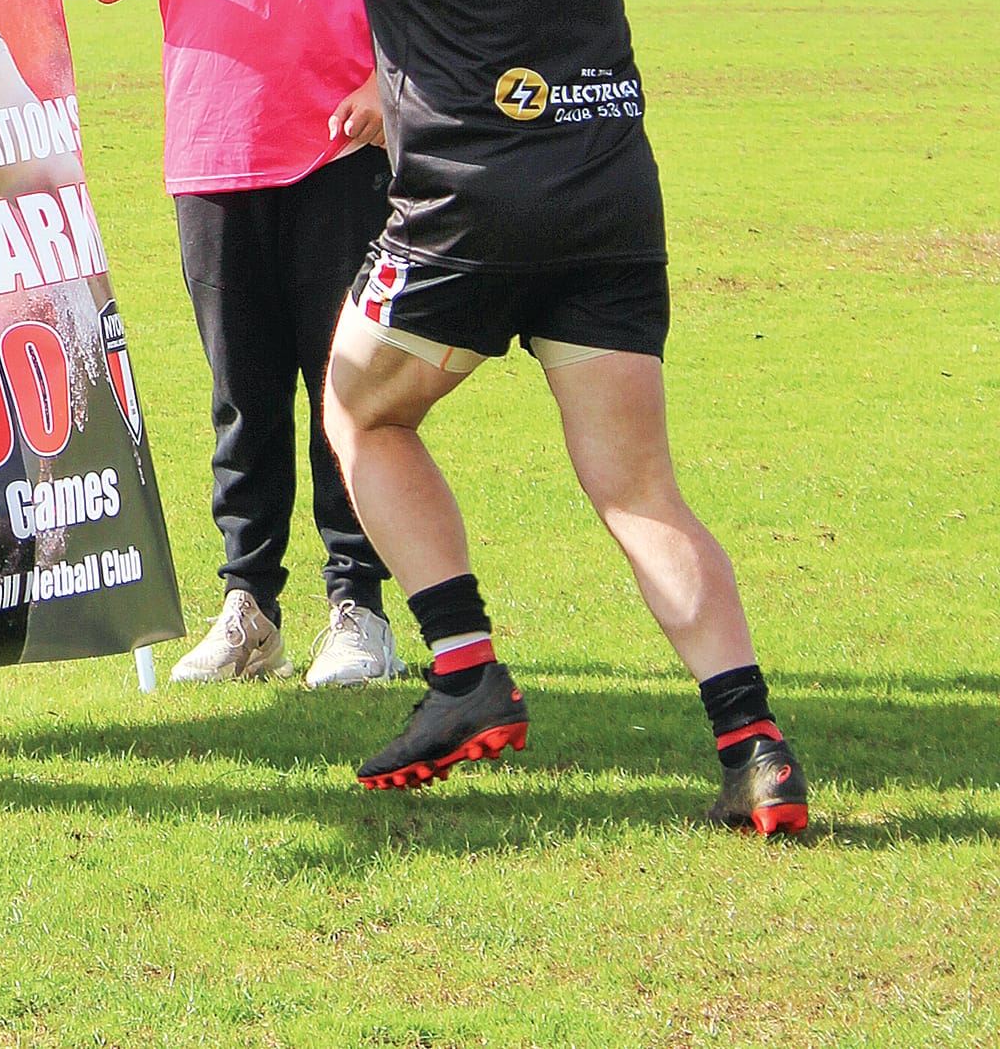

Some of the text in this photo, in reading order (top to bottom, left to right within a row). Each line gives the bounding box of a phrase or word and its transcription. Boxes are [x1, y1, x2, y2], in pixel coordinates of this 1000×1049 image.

[550, 79, 638, 104] ELECTRICA
[102, 313, 125, 340] NYO
[6, 467, 122, 540] Games
[24, 553, 99, 603] Netball
[100, 546, 143, 588] Club
